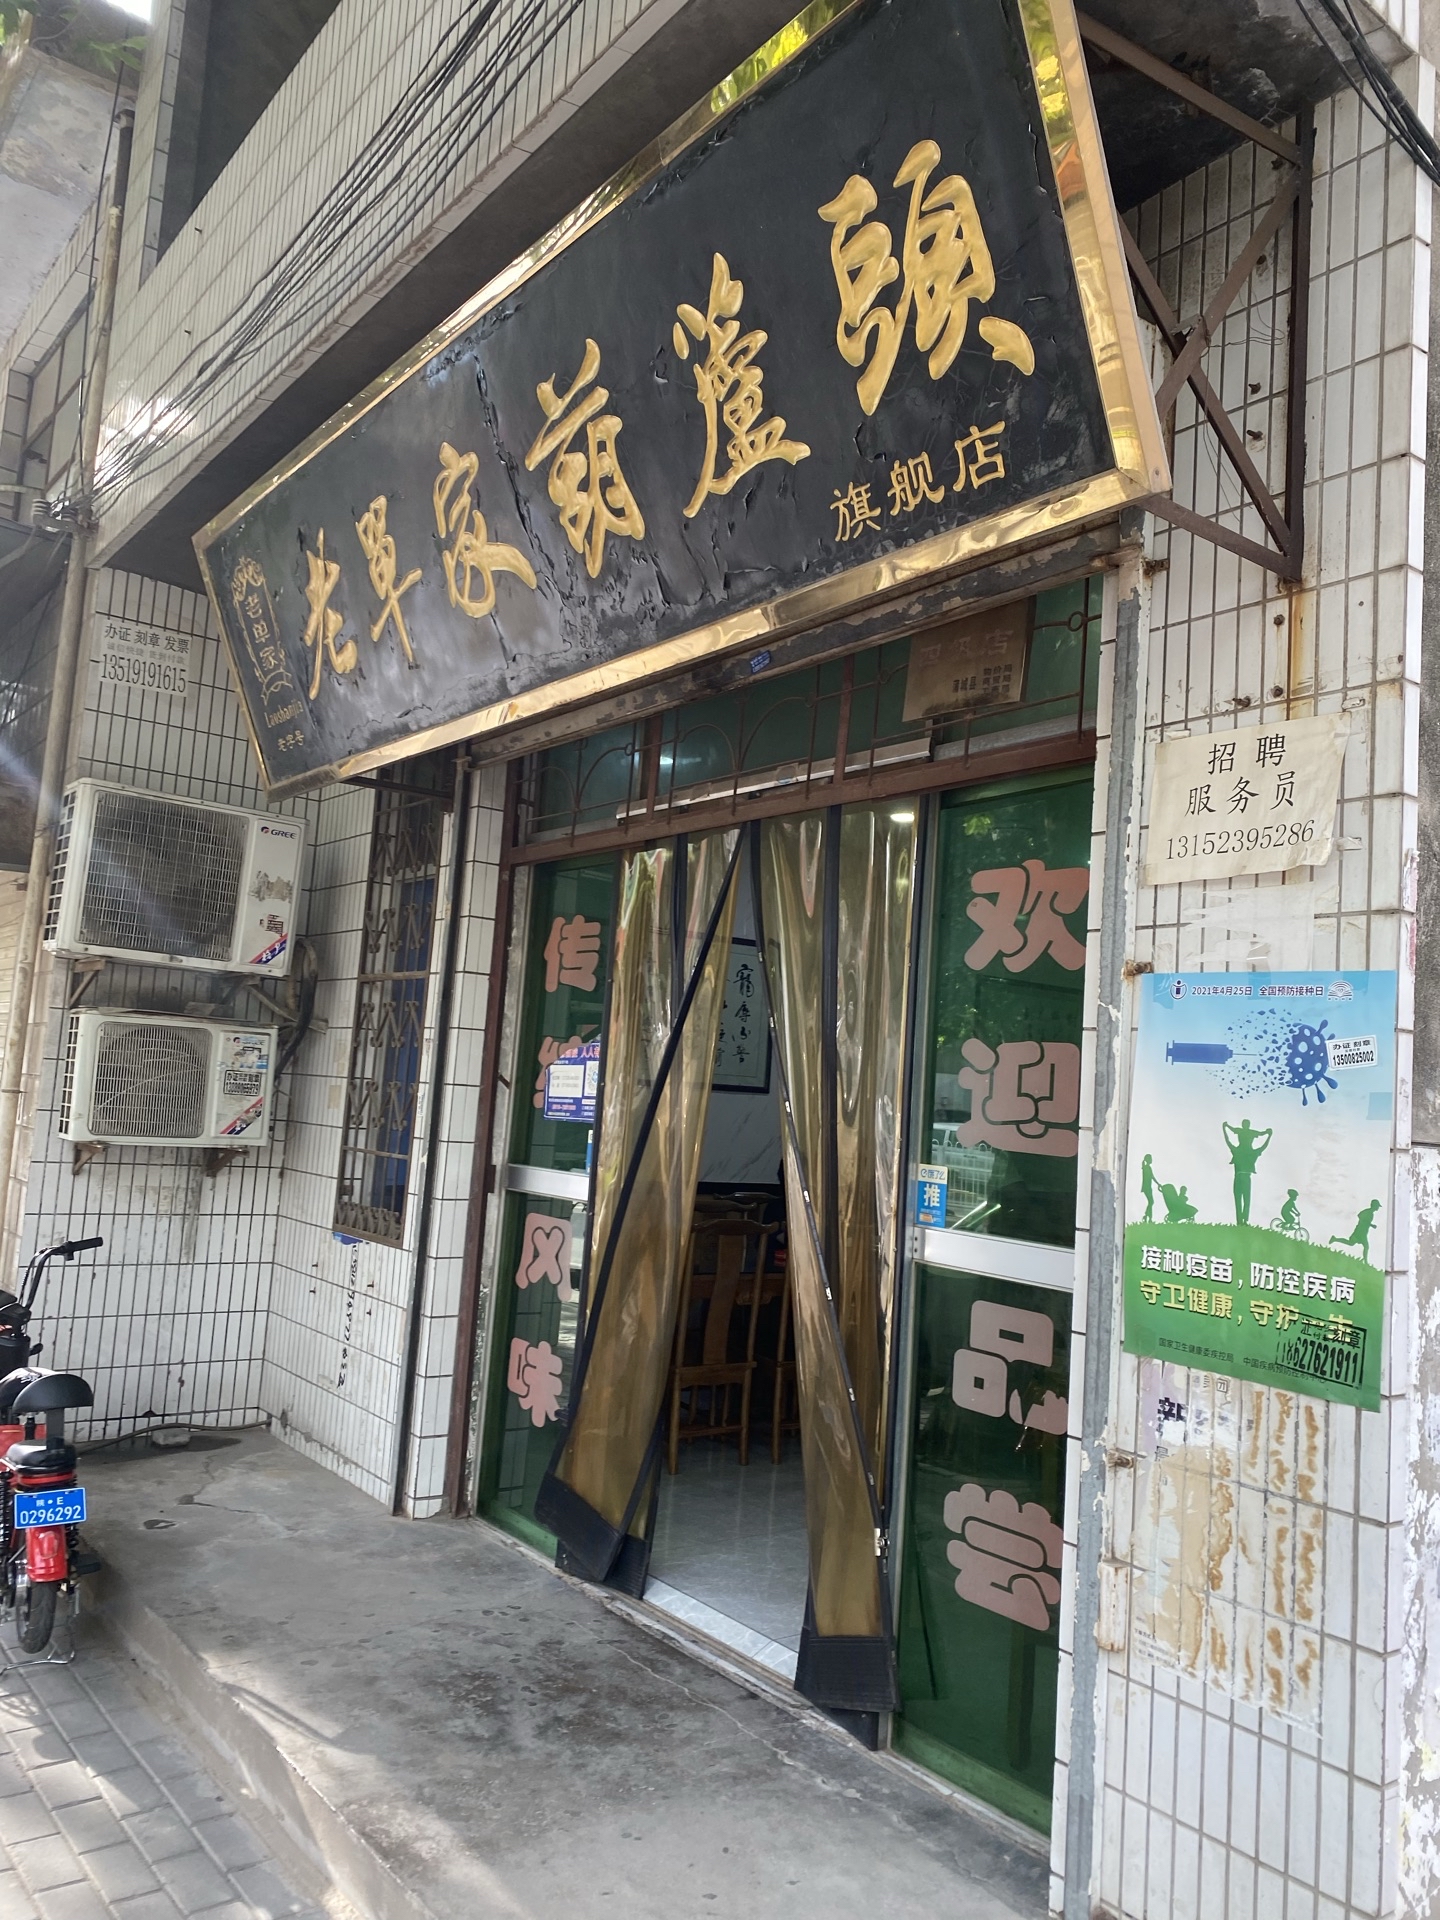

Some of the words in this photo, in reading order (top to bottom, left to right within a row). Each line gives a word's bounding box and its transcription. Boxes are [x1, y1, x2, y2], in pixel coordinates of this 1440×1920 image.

[829, 420, 1007, 542] 旗舰店
[104, 622, 132, 642] 办证
[134, 630, 161, 648] 刻章
[163, 635, 190, 655] 发票
[101, 653, 187, 693] 13519191615
[1207, 733, 1287, 775] 招聘
[1184, 770, 1296, 818] 服务员
[270, 829, 296, 840] GREE
[1166, 819, 1315, 860] 13152395286
[1191, 985, 1253, 996] 2021年4月25日
[1259, 985, 1324, 997] 全国预防接种日
[20, 1505, 82, 1525] 0296292
